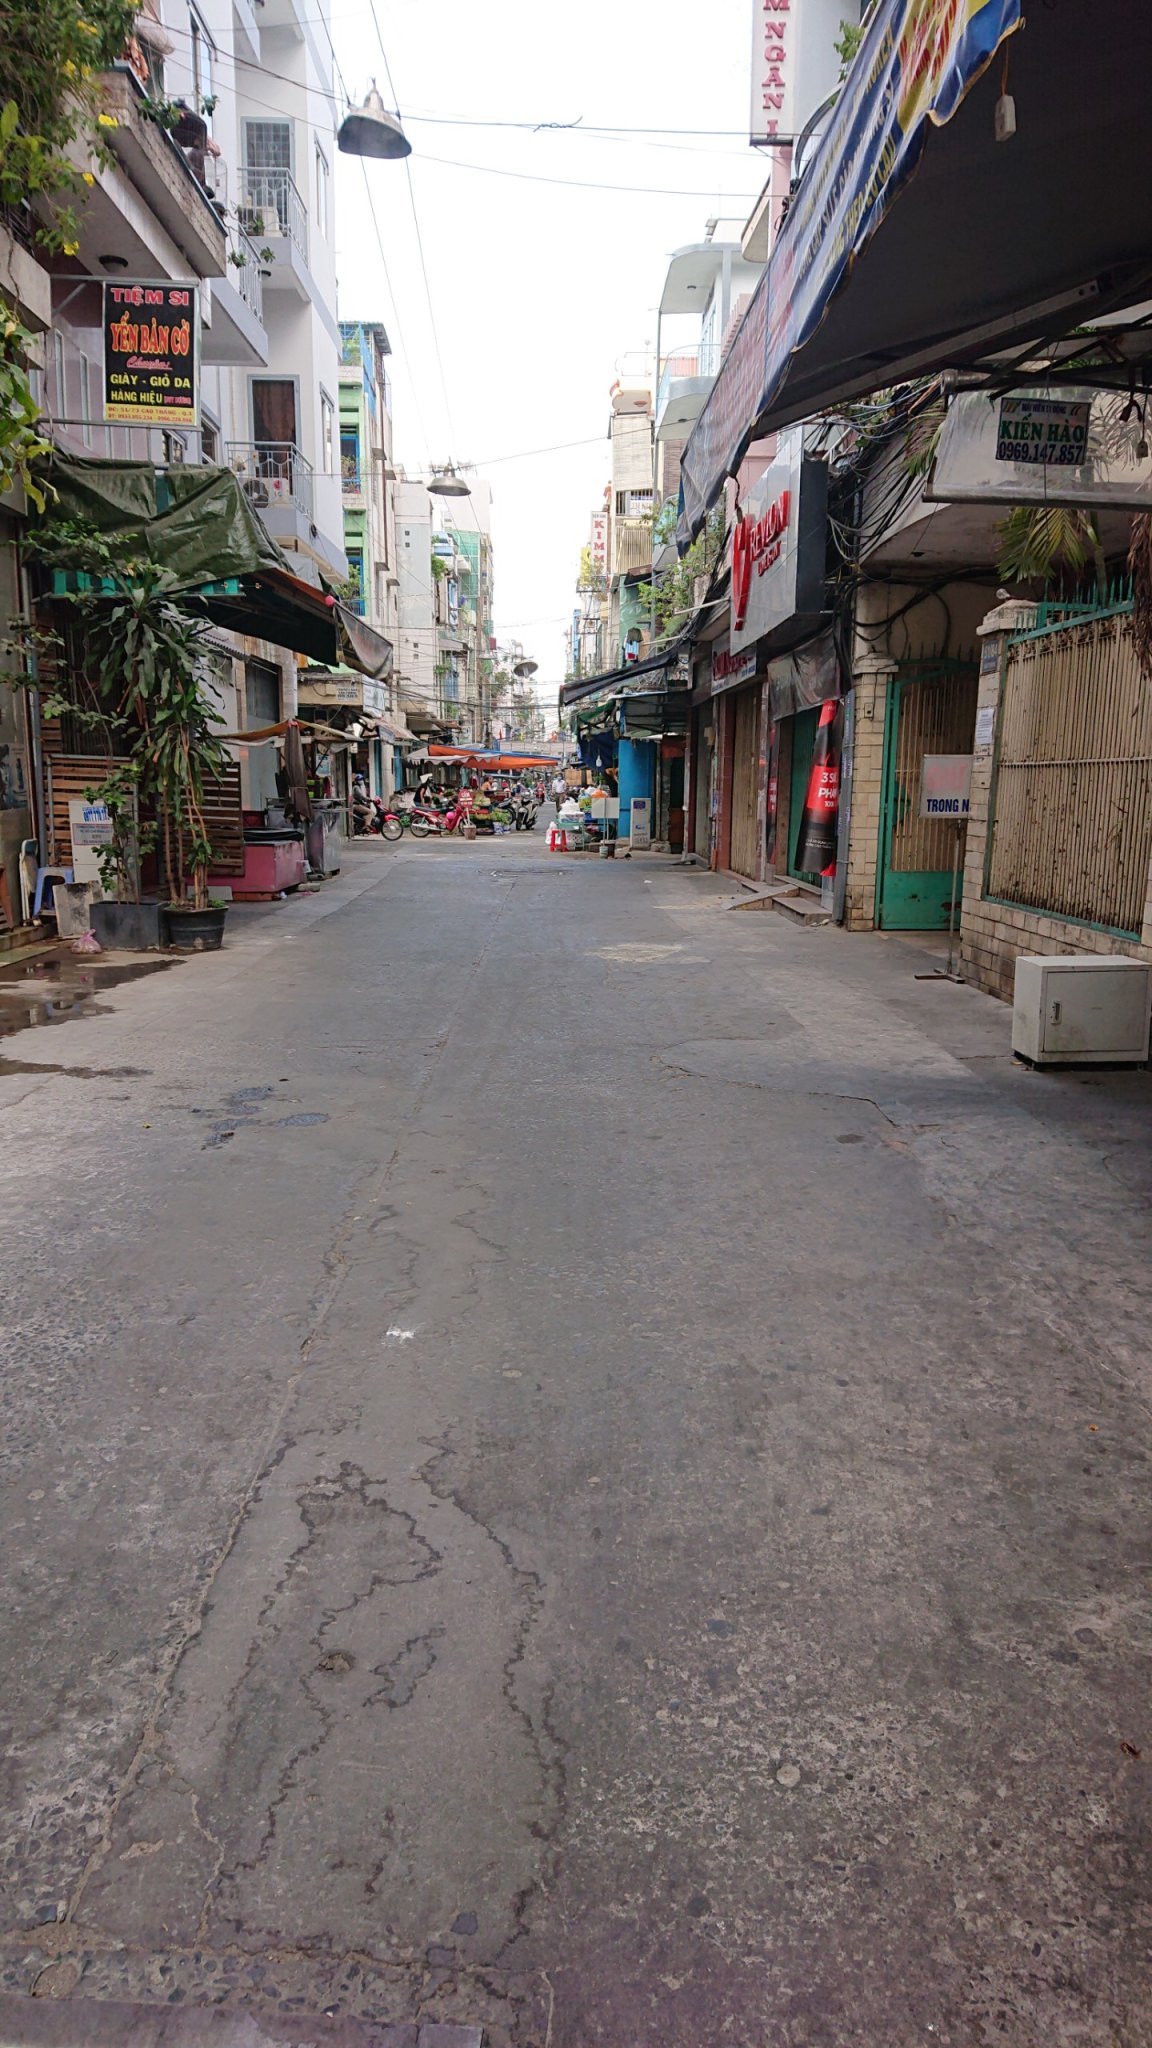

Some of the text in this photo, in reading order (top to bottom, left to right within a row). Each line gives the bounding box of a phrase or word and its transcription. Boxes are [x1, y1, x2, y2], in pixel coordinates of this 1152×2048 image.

[111, 285, 189, 306] TIỆM SI
[111, 311, 190, 356] YẾN BÀN CỜ
[110, 372, 138, 385] GIÀY
[149, 373, 170, 387] GIỎ
[174, 377, 191, 389] DA
[111, 388, 137, 402] HÀNG
[139, 390, 163, 405] HIỆU
[1000, 412, 1085, 443] KIẾN HÀO
[999, 441, 1084, 462] 0969.147.857
[927, 799, 959, 812] TRONG
